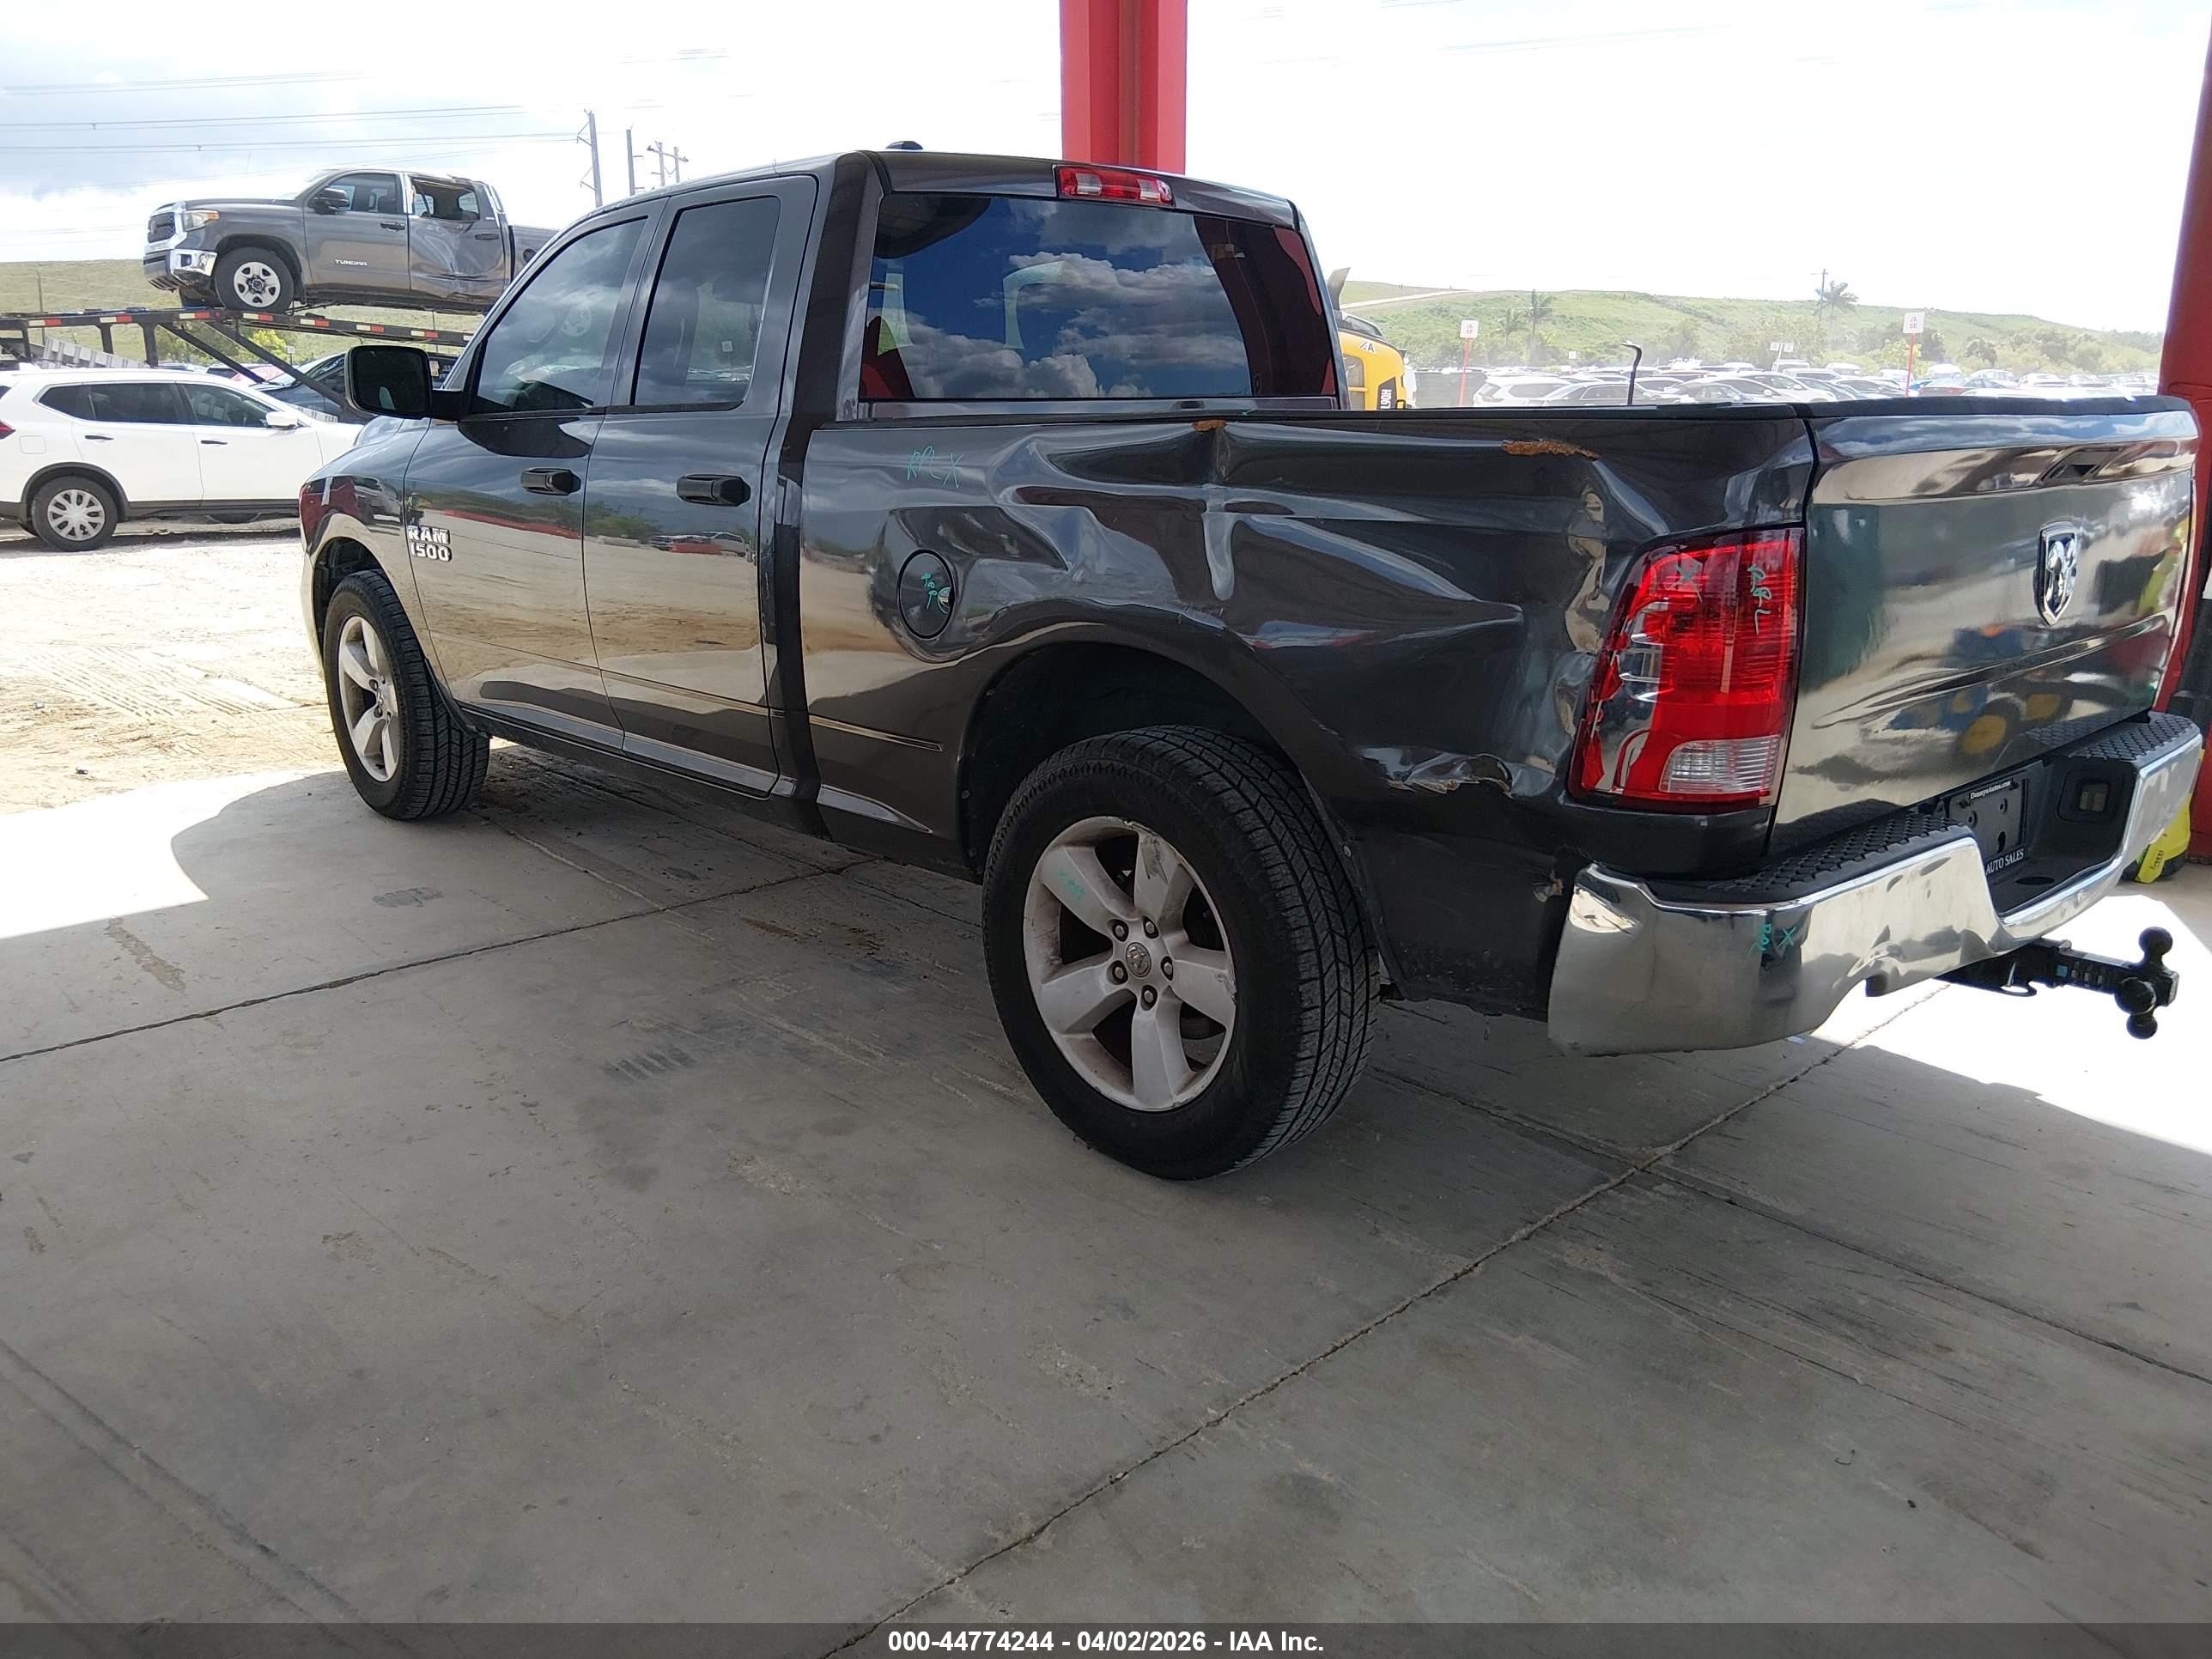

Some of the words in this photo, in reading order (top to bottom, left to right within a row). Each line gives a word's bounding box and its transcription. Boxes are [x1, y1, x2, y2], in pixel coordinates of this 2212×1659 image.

[1380, 389, 1392, 410] L90H
[407, 525, 451, 544] RAM
[410, 541, 453, 562] 1500
[1985, 857, 2004, 876] AUTO
[2005, 848, 2025, 866] SALES
